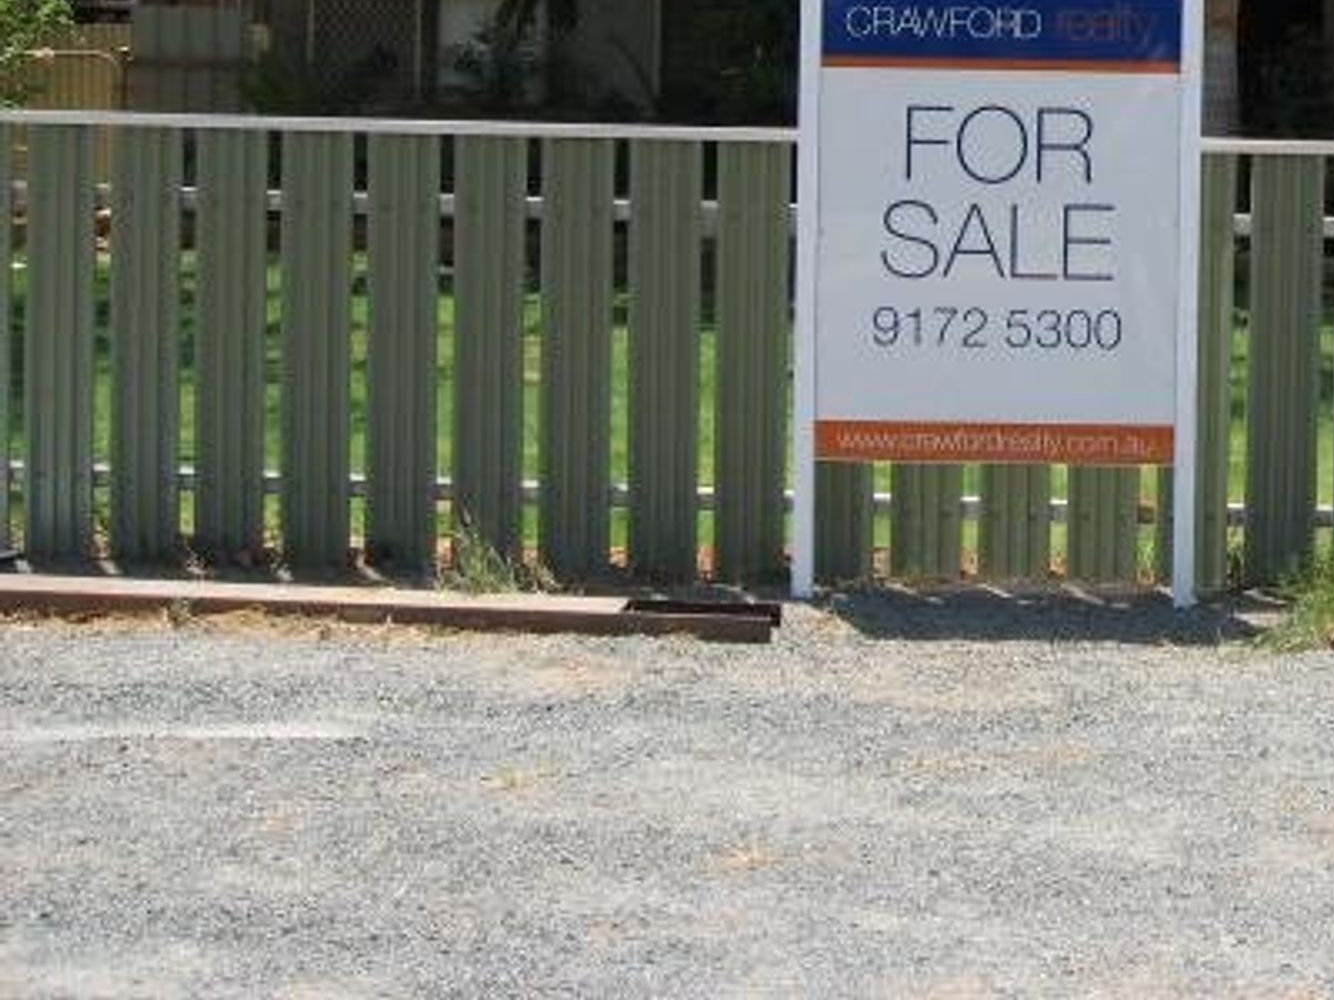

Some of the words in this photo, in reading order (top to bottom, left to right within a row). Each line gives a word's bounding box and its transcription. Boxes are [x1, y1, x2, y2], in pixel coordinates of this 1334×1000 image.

[845, 4, 1042, 40] CRAWFORD
[1057, 1, 1158, 48] realty
[904, 105, 1094, 184] FOR
[880, 200, 1116, 281] SALE
[871, 306, 988, 349] 9172
[1005, 309, 1122, 351] 5300
[835, 428, 1155, 458] www.crawfordrealty.com.au
